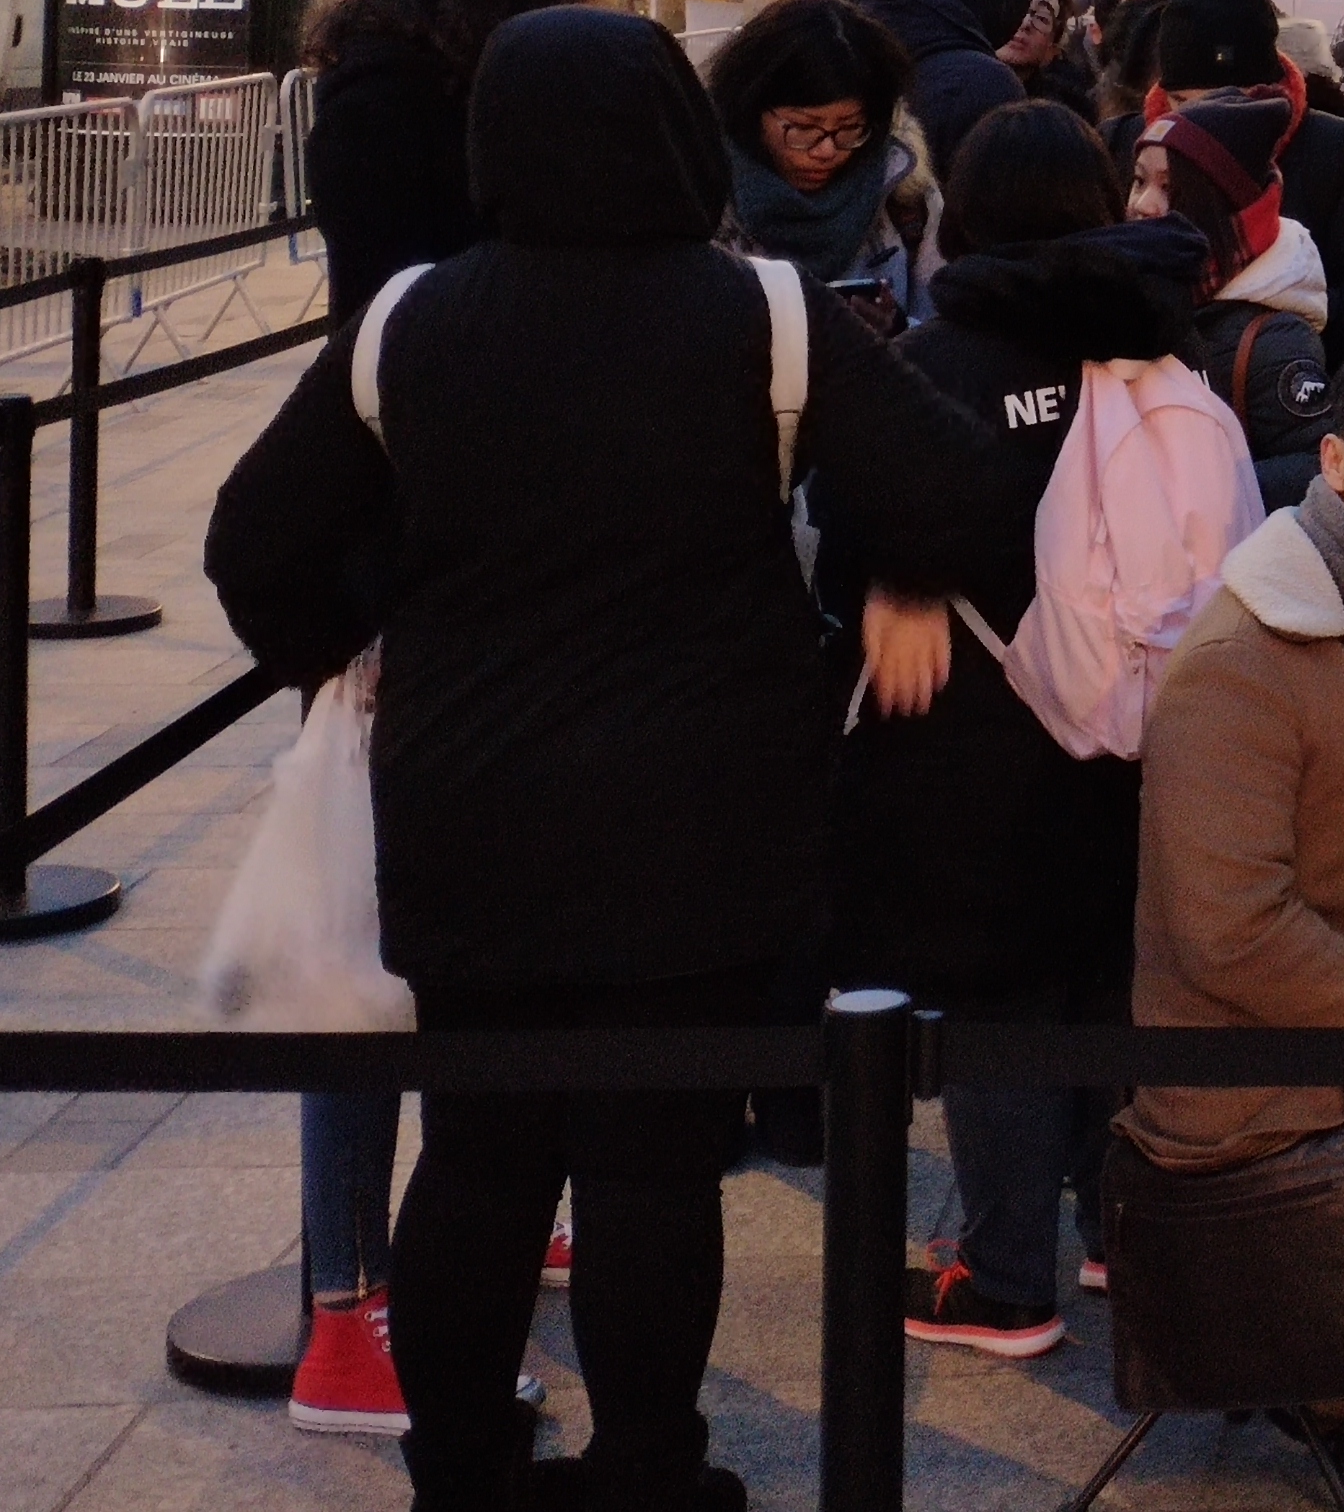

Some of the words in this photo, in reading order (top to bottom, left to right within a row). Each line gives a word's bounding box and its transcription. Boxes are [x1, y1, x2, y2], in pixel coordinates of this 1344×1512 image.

[72, 71, 83, 82] LE
[83, 71, 95, 83] 23
[96, 72, 145, 84] JANVIER
[147, 74, 166, 85] AU
